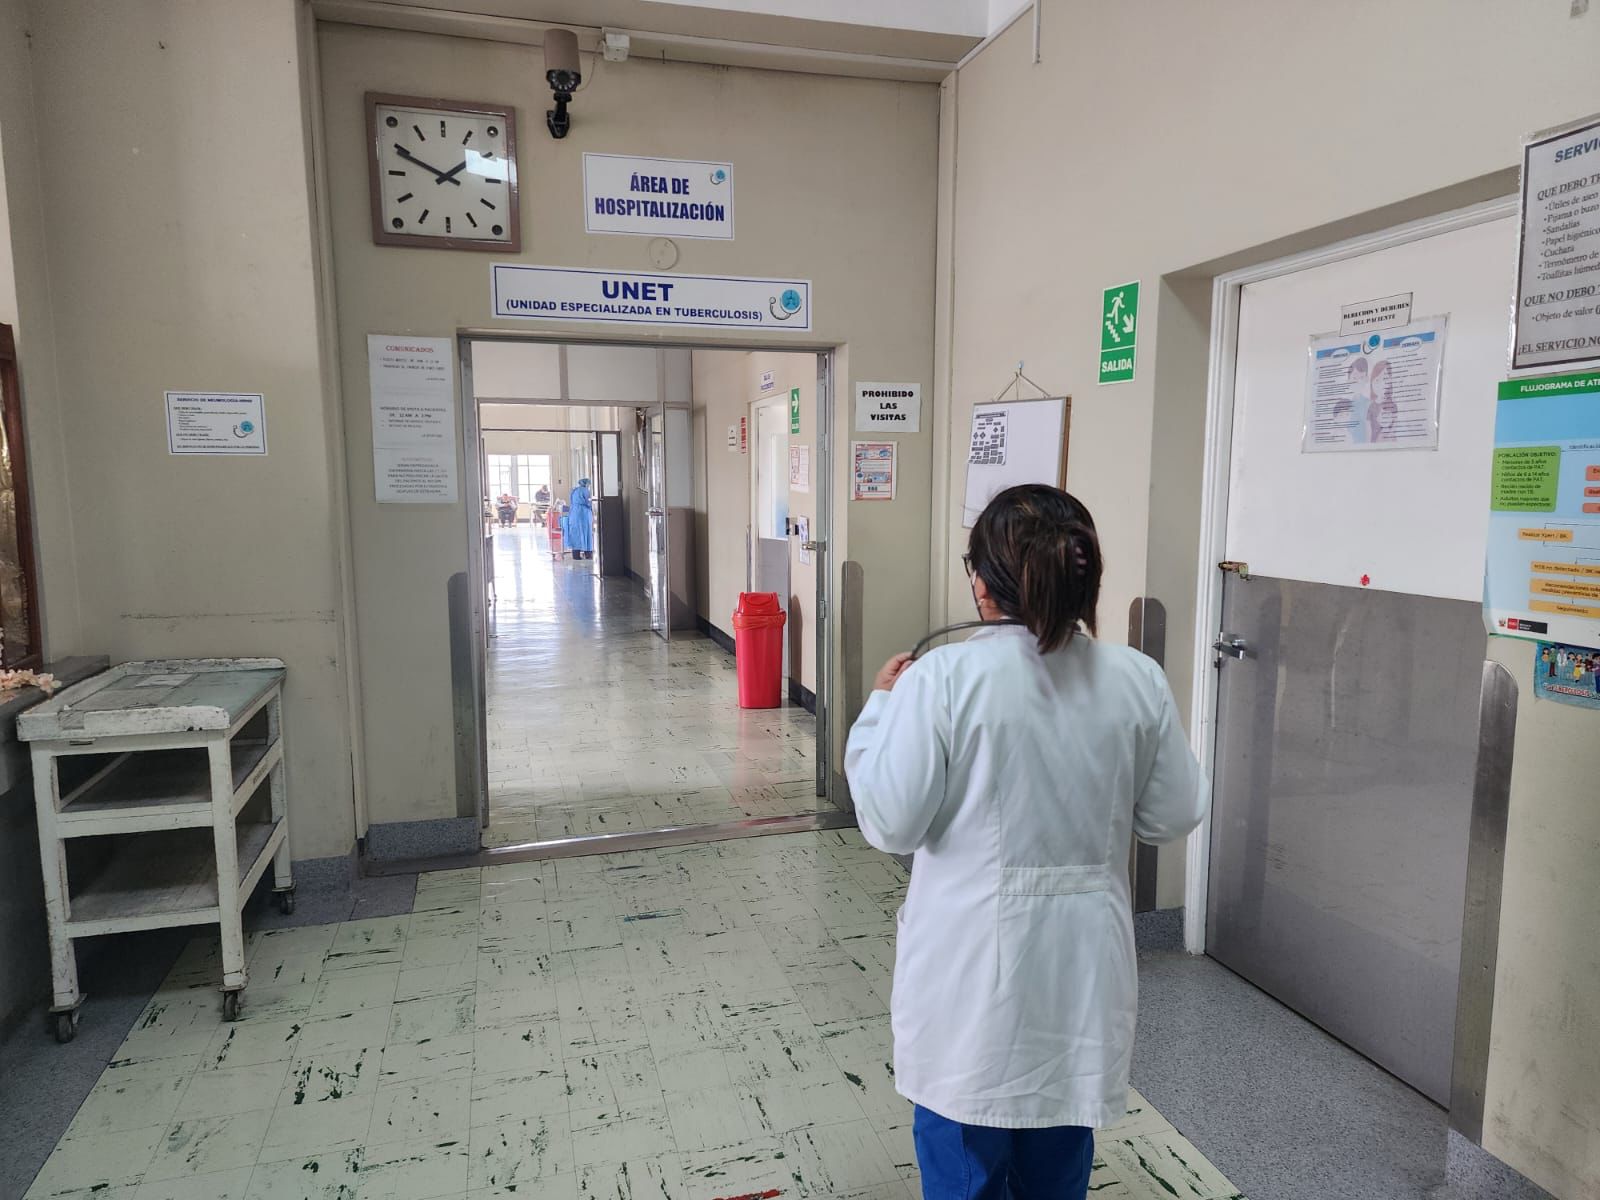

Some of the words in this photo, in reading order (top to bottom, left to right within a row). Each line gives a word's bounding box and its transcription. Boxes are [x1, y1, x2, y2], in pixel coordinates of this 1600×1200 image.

[630, 172, 668, 194] ÁREA
[672, 178, 690, 195] DE
[1537, 185, 1557, 201] QUE
[1559, 177, 1588, 194] DEBO
[1582, 191, 1599, 202] aseo
[595, 197, 725, 222] HOSPITALIZACIÓN
[1547, 211, 1573, 223] Pijama
[1581, 203, 1600, 214] buzo
[1546, 221, 1580, 234] Sandalias
[1545, 233, 1566, 246] Papel
[1544, 245, 1575, 258] Cuchara
[1589, 250, 1599, 260] de
[1541, 270, 1573, 280] Toallitas
[601, 280, 674, 302] UNET
[1524, 294, 1546, 307] QUE
[1548, 291, 1564, 301] NO
[1566, 285, 1596, 299] DEBO
[506, 298, 557, 312] (UNIDAD
[560, 301, 652, 316] ESPECIALIZADA
[656, 306, 671, 317] EN
[674, 307, 763, 322] TUBERCULOSIS)
[1535, 311, 1561, 322] Objeto
[1563, 309, 1573, 318] de
[1574, 306, 1594, 316] valor
[1536, 337, 1586, 352] SERVICIO
[1102, 358, 1132, 373] SALIDA
[1520, 381, 1572, 392] FLUJOGRAMA
[1574, 379, 1586, 387] DE
[862, 390, 914, 398] PROHIBIDO
[880, 402, 898, 410] LAS
